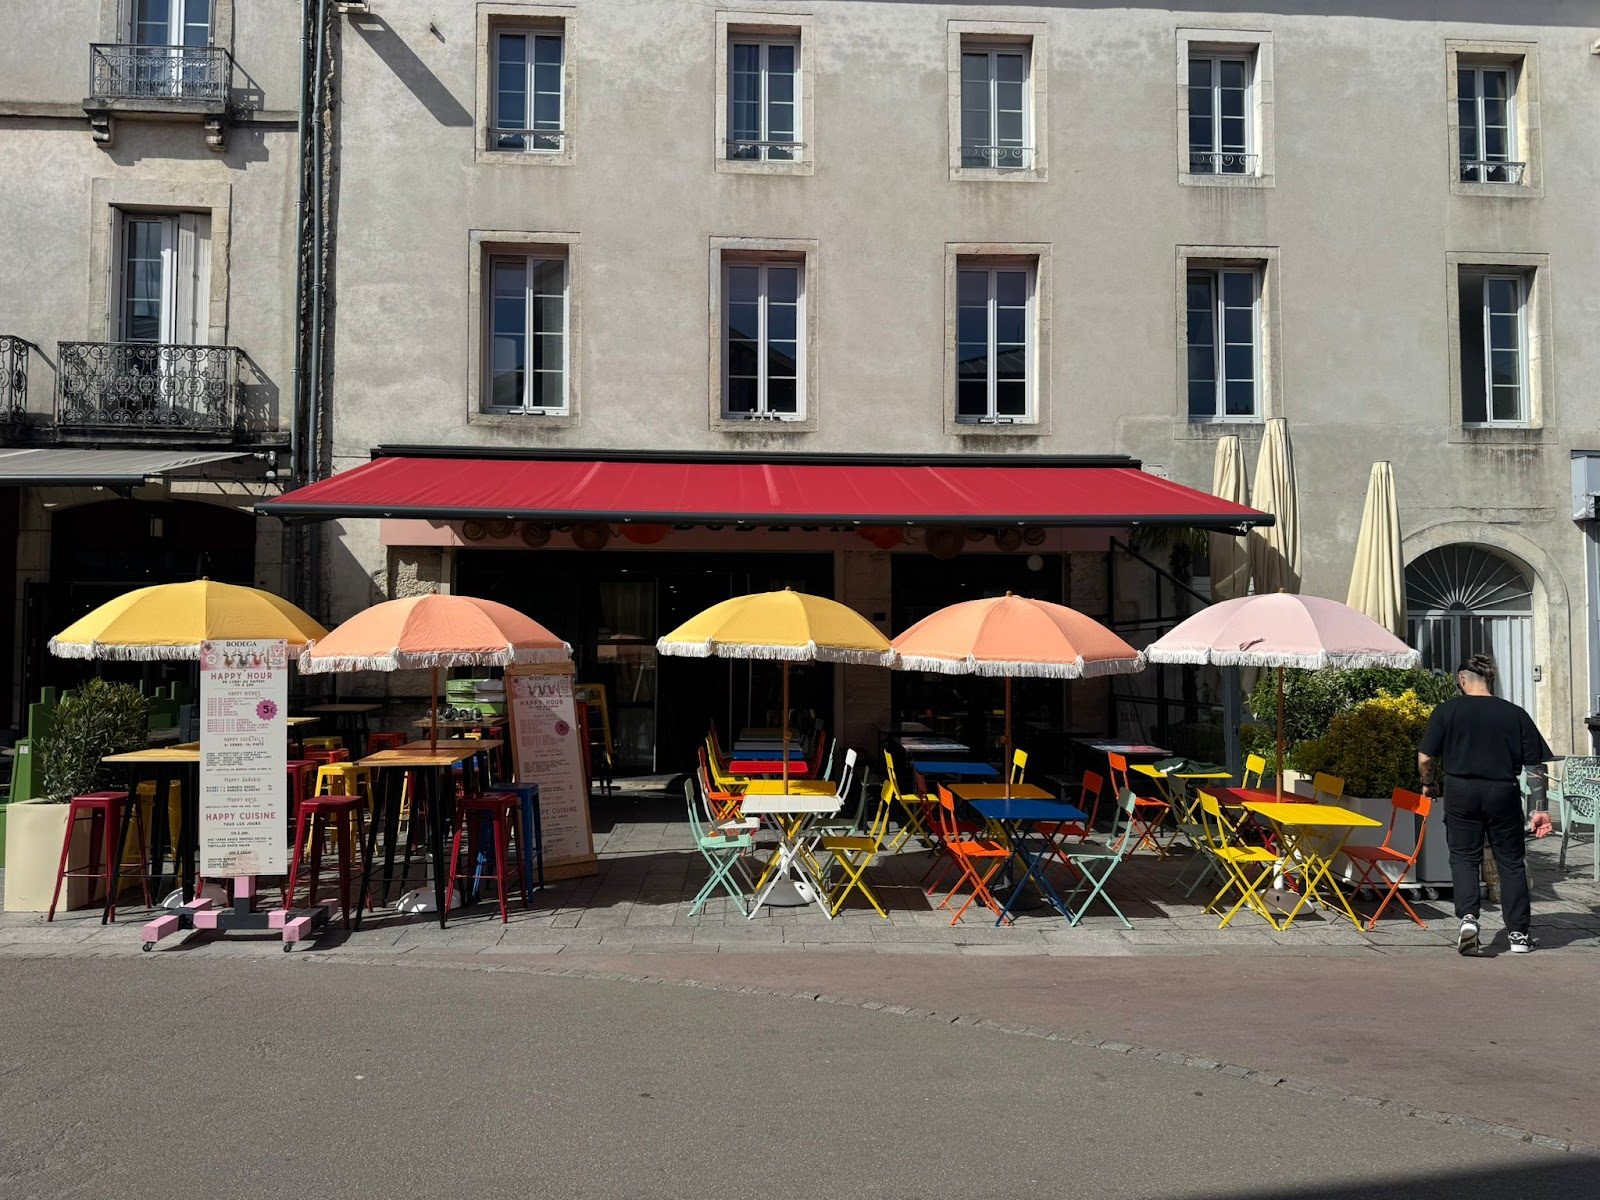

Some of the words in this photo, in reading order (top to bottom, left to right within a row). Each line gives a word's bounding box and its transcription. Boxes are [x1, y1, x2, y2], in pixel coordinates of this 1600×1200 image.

[247, 672, 273, 680] HOUR
[263, 704, 275, 714] 5€
[206, 813, 235, 821] HAPPY
[239, 812, 276, 820] CUISINE
